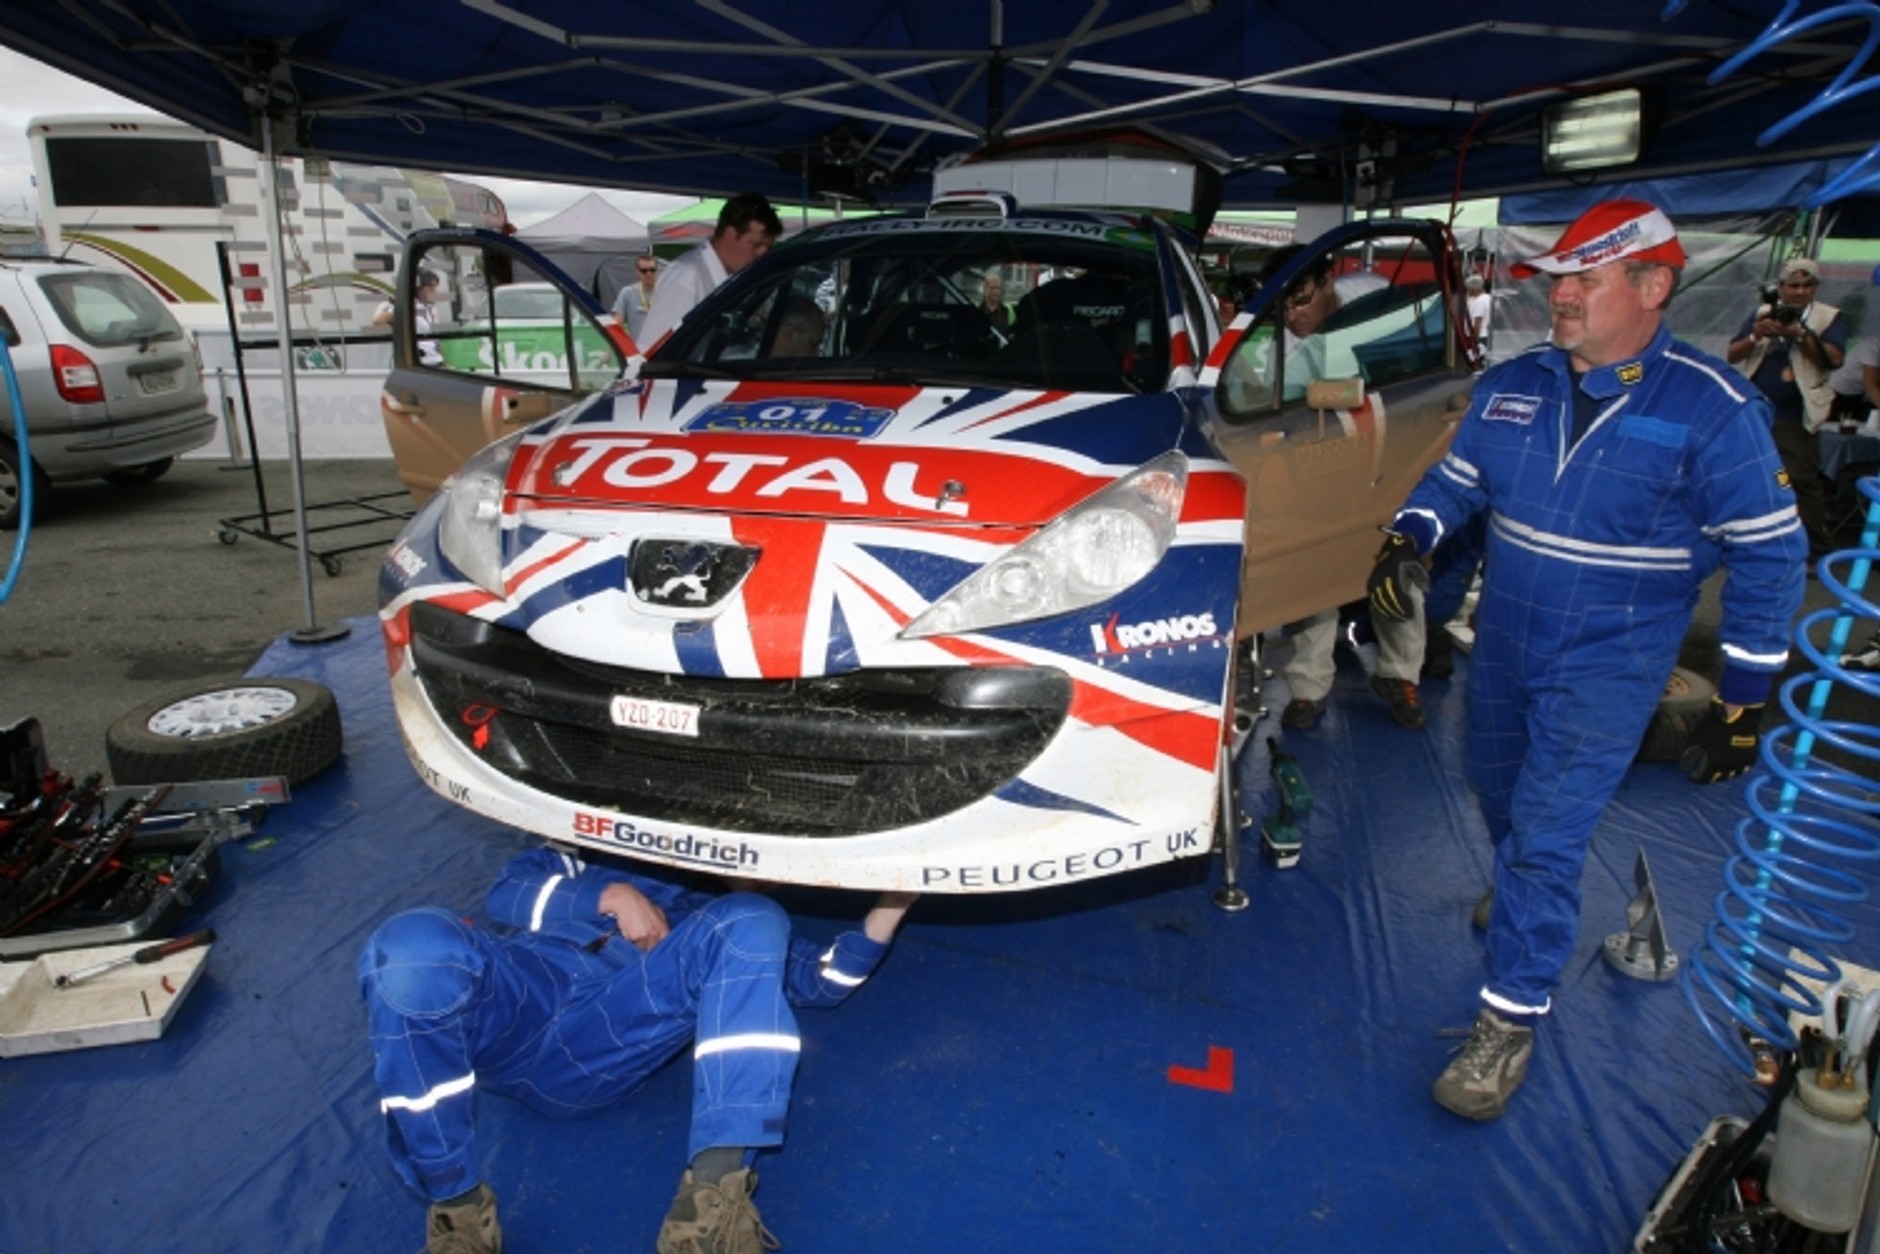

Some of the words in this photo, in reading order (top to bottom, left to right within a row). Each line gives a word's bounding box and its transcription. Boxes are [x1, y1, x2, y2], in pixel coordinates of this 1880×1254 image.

[758, 405, 828, 422] 01
[558, 438, 970, 518] TOTAL
[1090, 610, 1218, 654] KRONOS
[448, 779, 473, 804] UK
[573, 811, 760, 865] BFGoodrich
[922, 839, 1151, 887] PEUGEOT
[1166, 827, 1199, 853] UK
